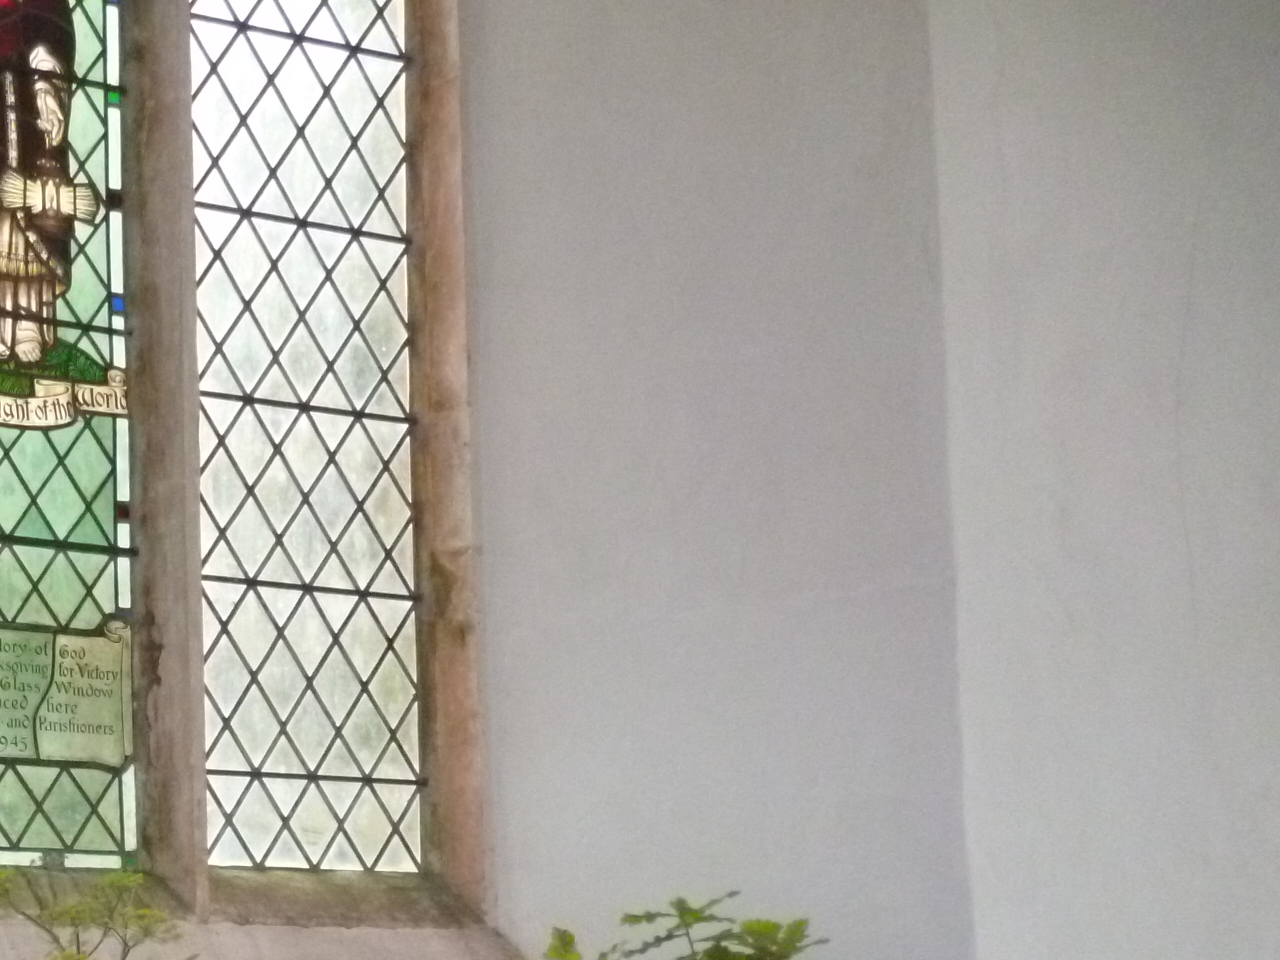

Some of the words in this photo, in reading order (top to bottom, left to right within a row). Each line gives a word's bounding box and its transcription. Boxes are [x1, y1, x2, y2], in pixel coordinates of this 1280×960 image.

[34, 399, 49, 421] of
[51, 398, 74, 421] the
[34, 641, 50, 657] of
[59, 644, 86, 660] God
[59, 662, 74, 678] for
[76, 663, 119, 687] Victory
[0, 675, 41, 694] Glass
[54, 681, 114, 699] Window
[47, 697, 78, 715] here
[6, 714, 30, 729] and
[39, 715, 115, 736] Parishioners
